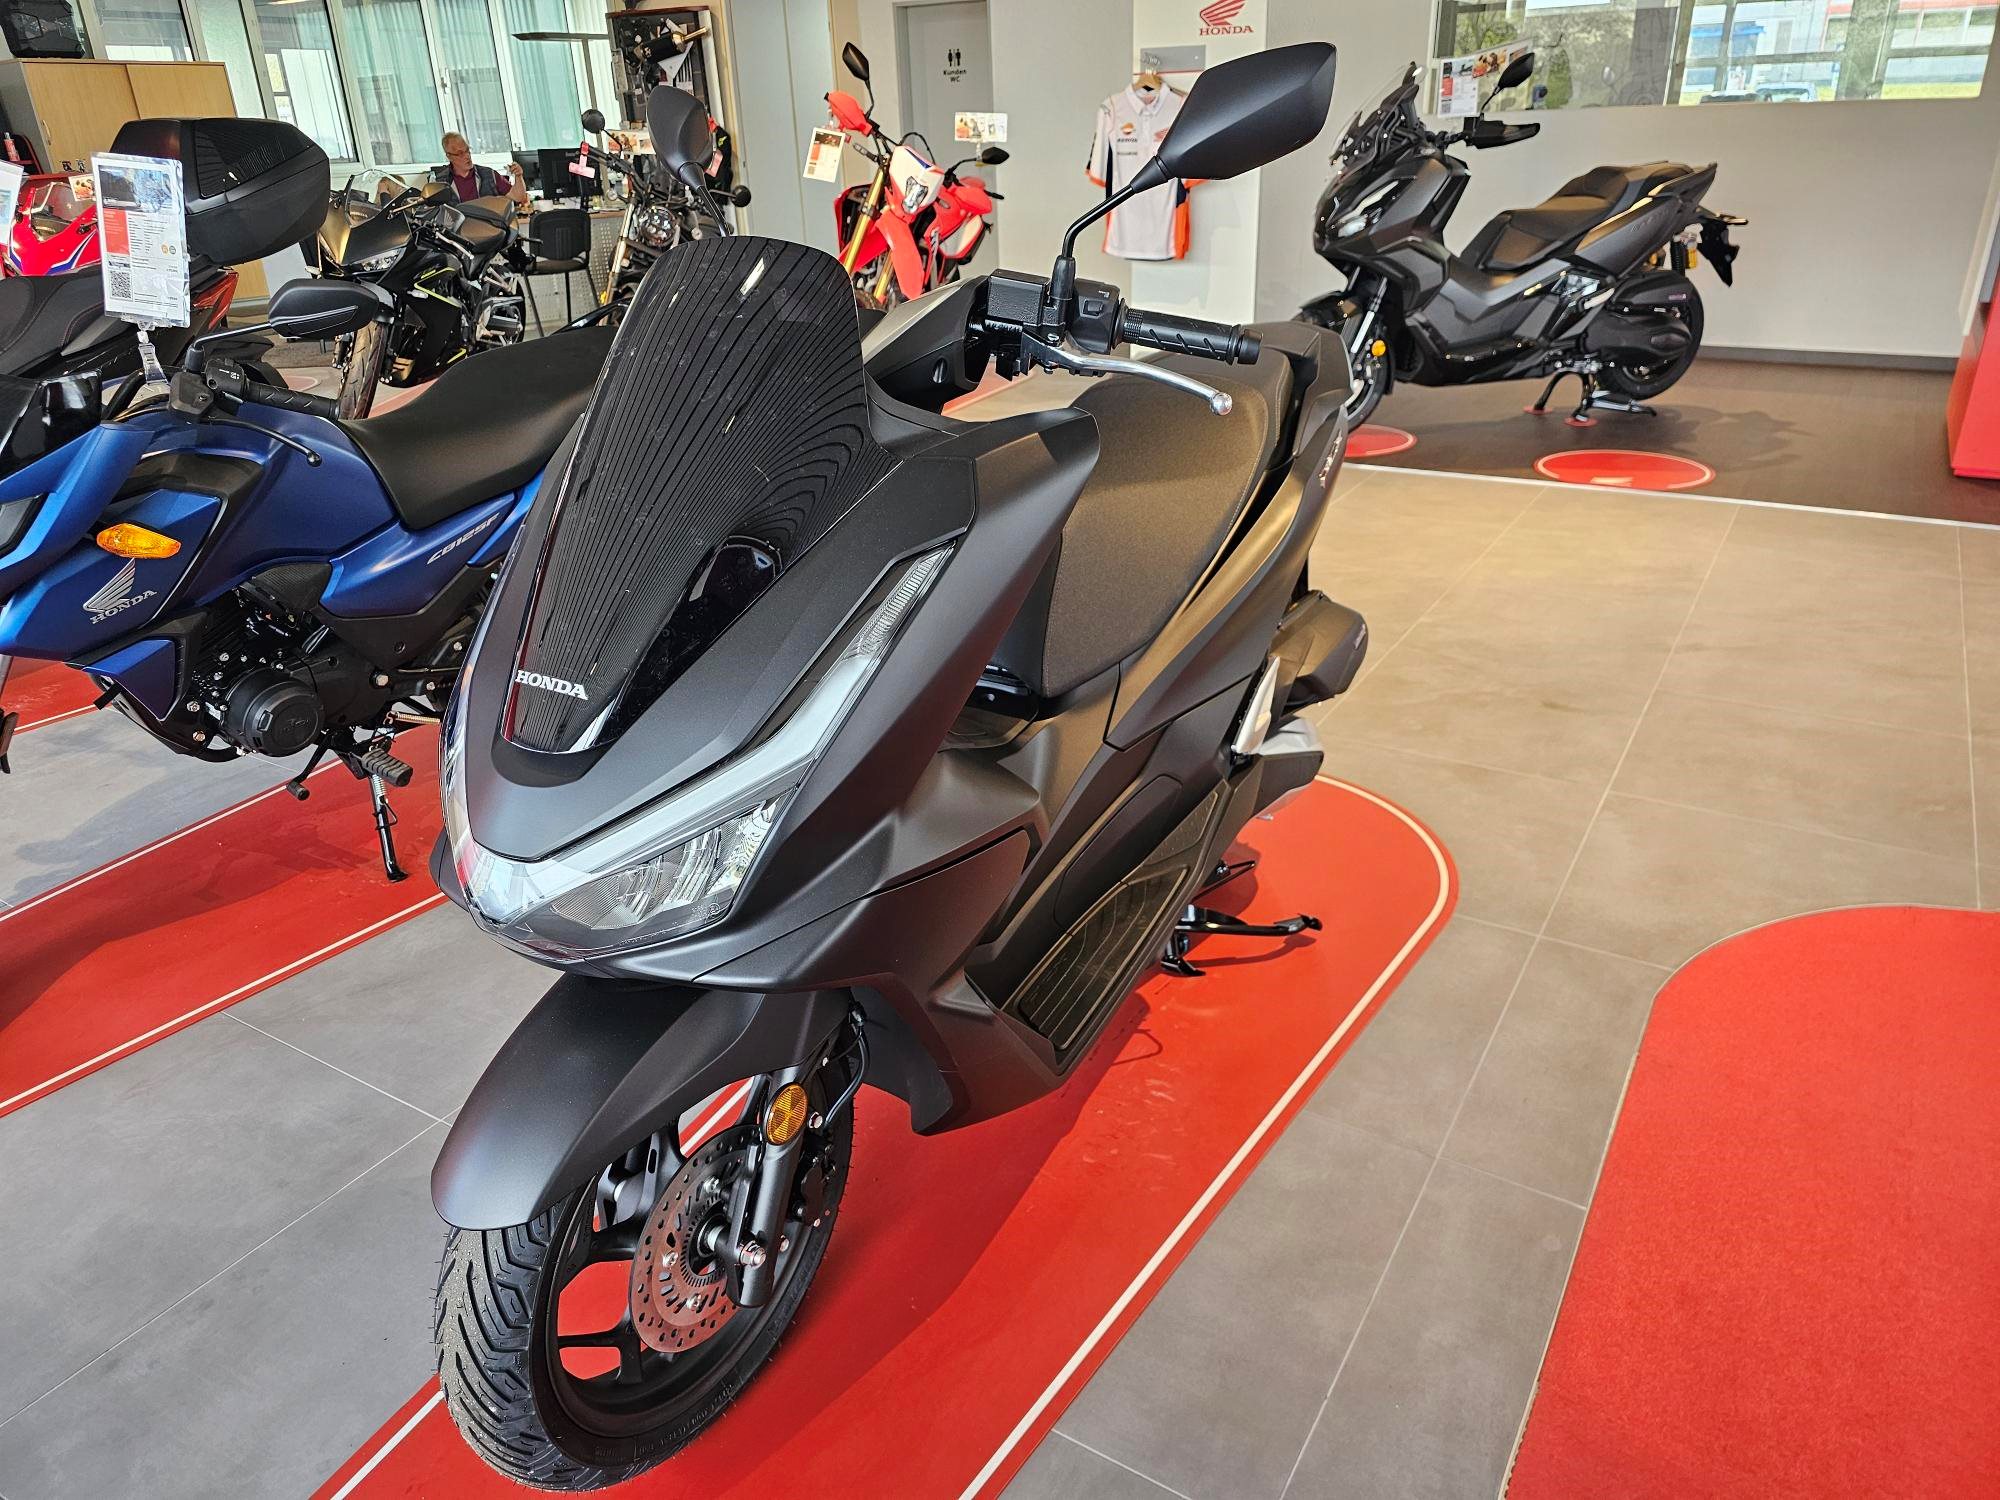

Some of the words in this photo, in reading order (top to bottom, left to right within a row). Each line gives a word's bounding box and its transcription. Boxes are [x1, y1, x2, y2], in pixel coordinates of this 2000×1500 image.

[1199, 25, 1254, 36] HONDA
[89, 590, 158, 625] HONDA
[514, 669, 589, 701] HONDA
